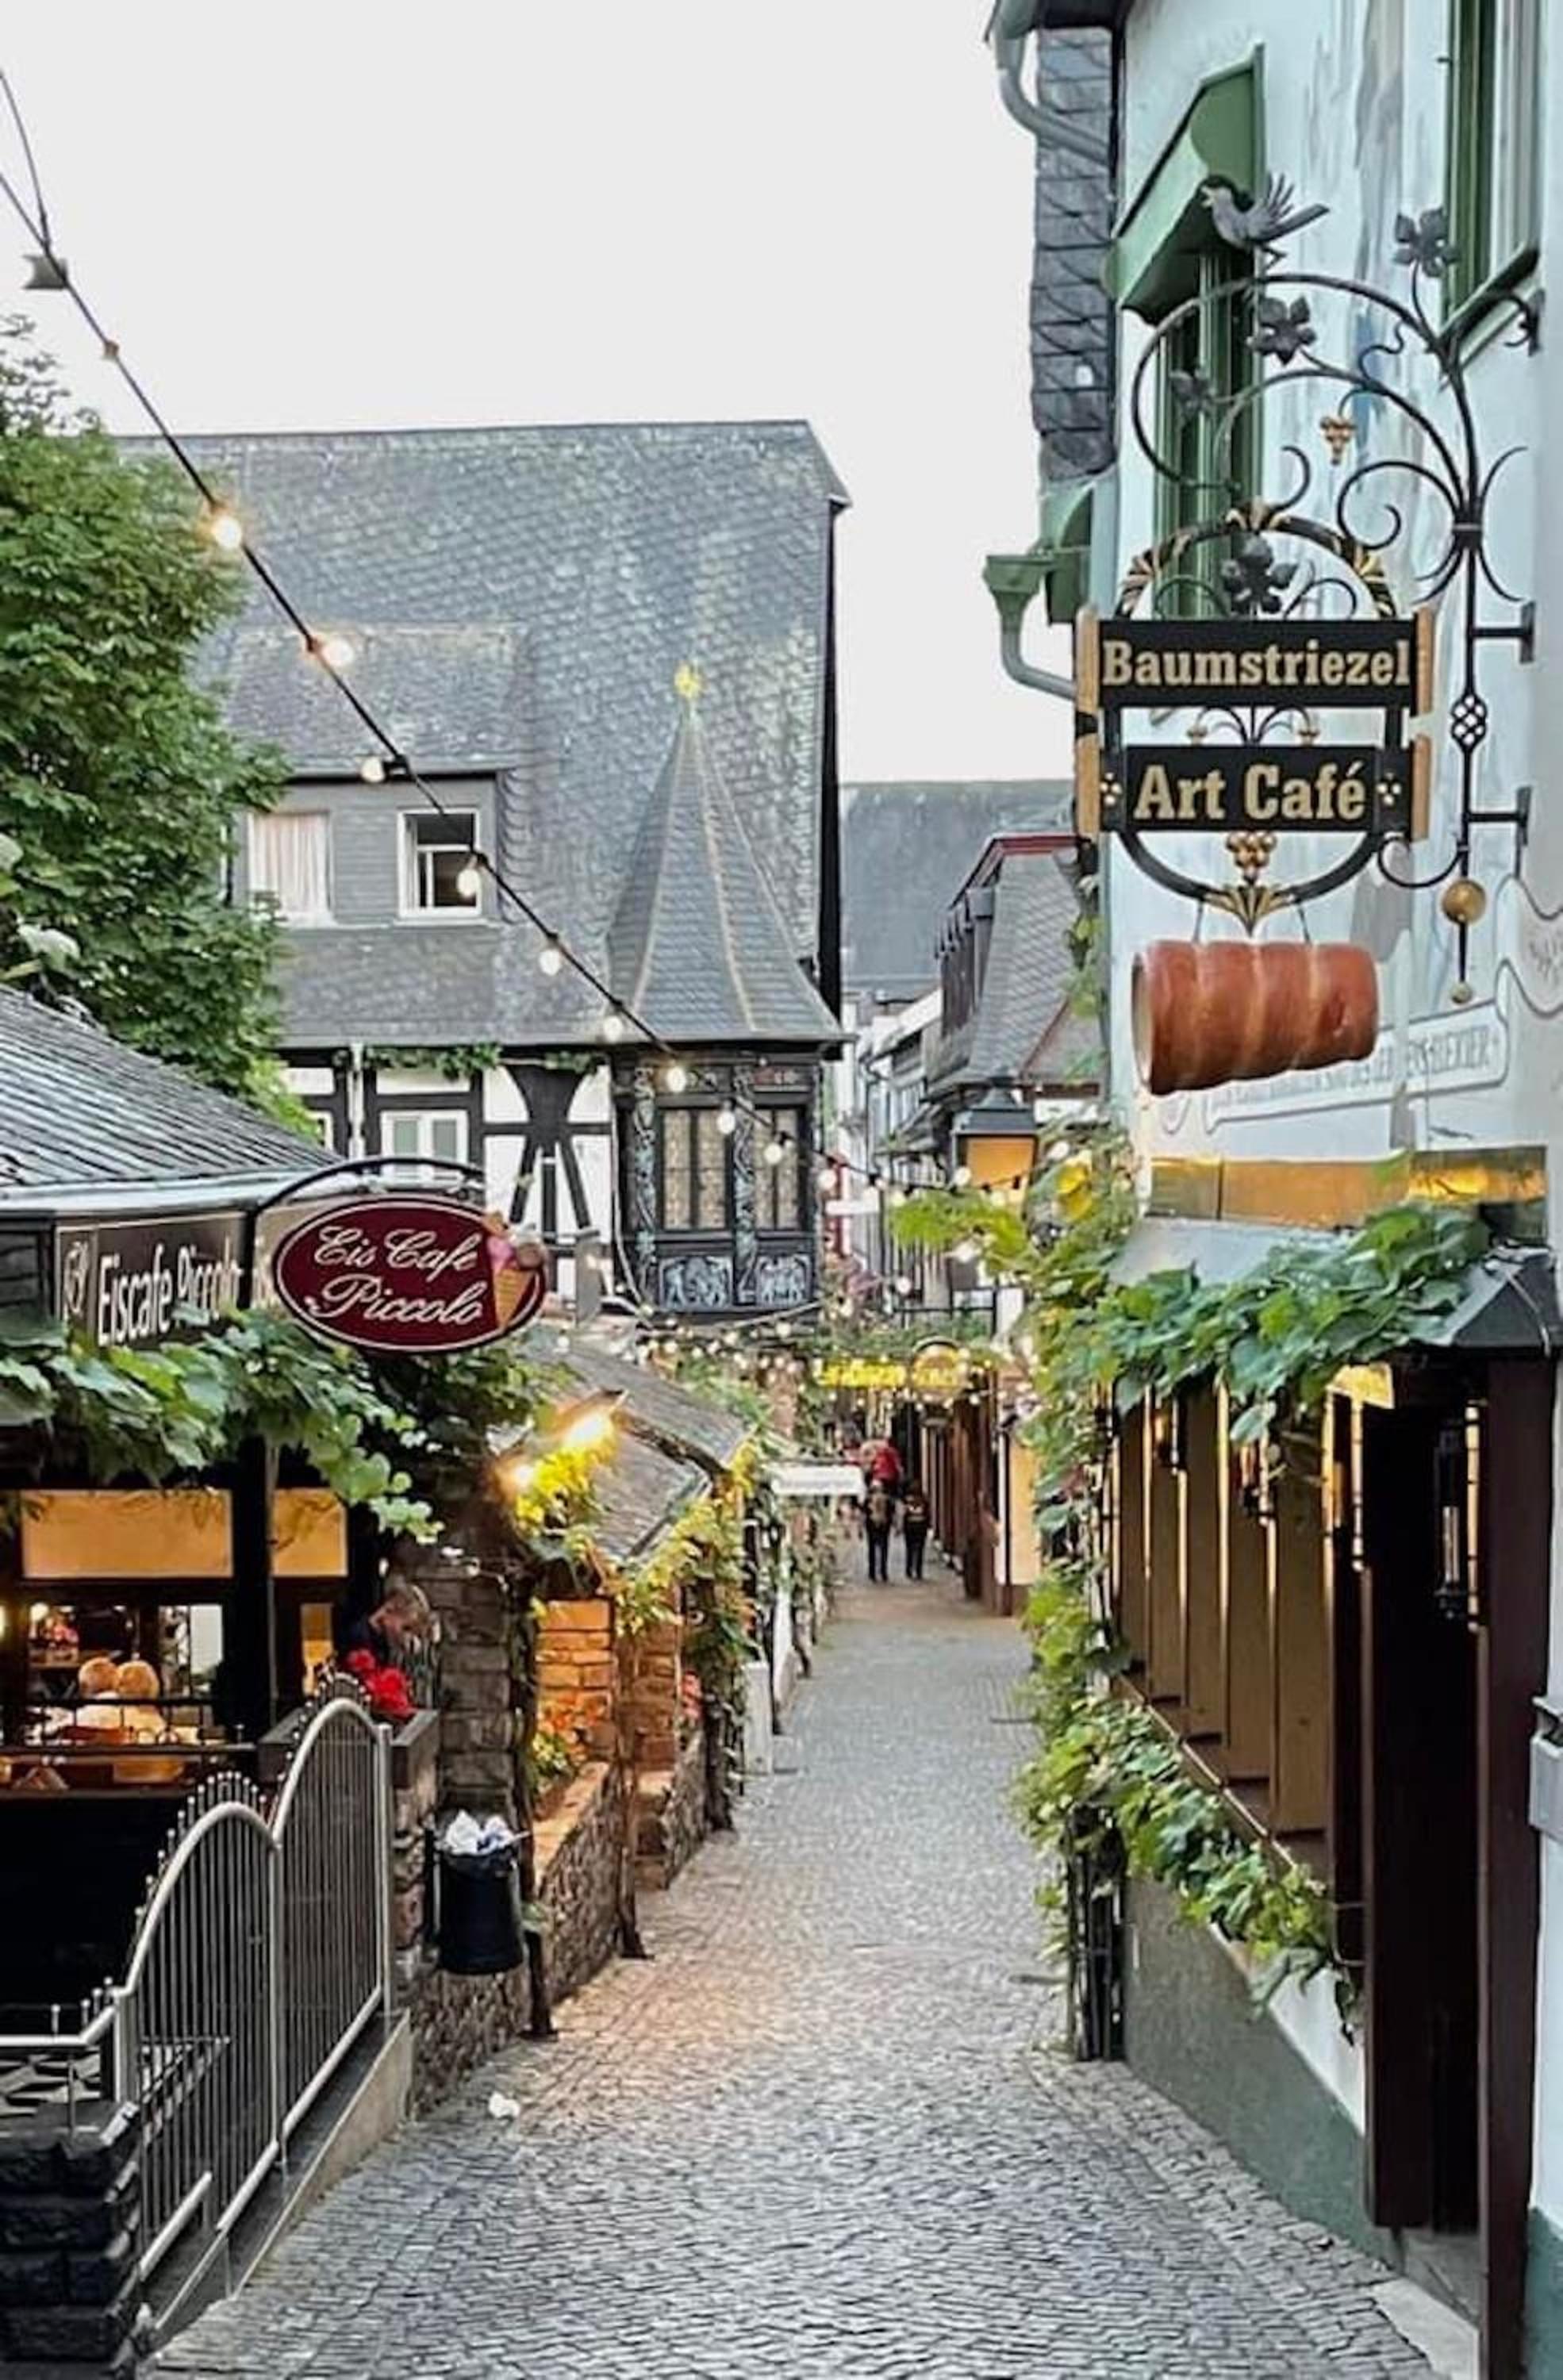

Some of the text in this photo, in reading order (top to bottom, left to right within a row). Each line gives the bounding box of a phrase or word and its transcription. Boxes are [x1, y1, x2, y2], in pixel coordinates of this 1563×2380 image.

[1101, 639, 1410, 686] Baumstriezel
[1133, 761, 1366, 820] Art Café
[314, 1226, 482, 1283] Eis Cafe
[98, 1242, 172, 1347] Eiscafe
[304, 1273, 488, 1325] Piccolo
